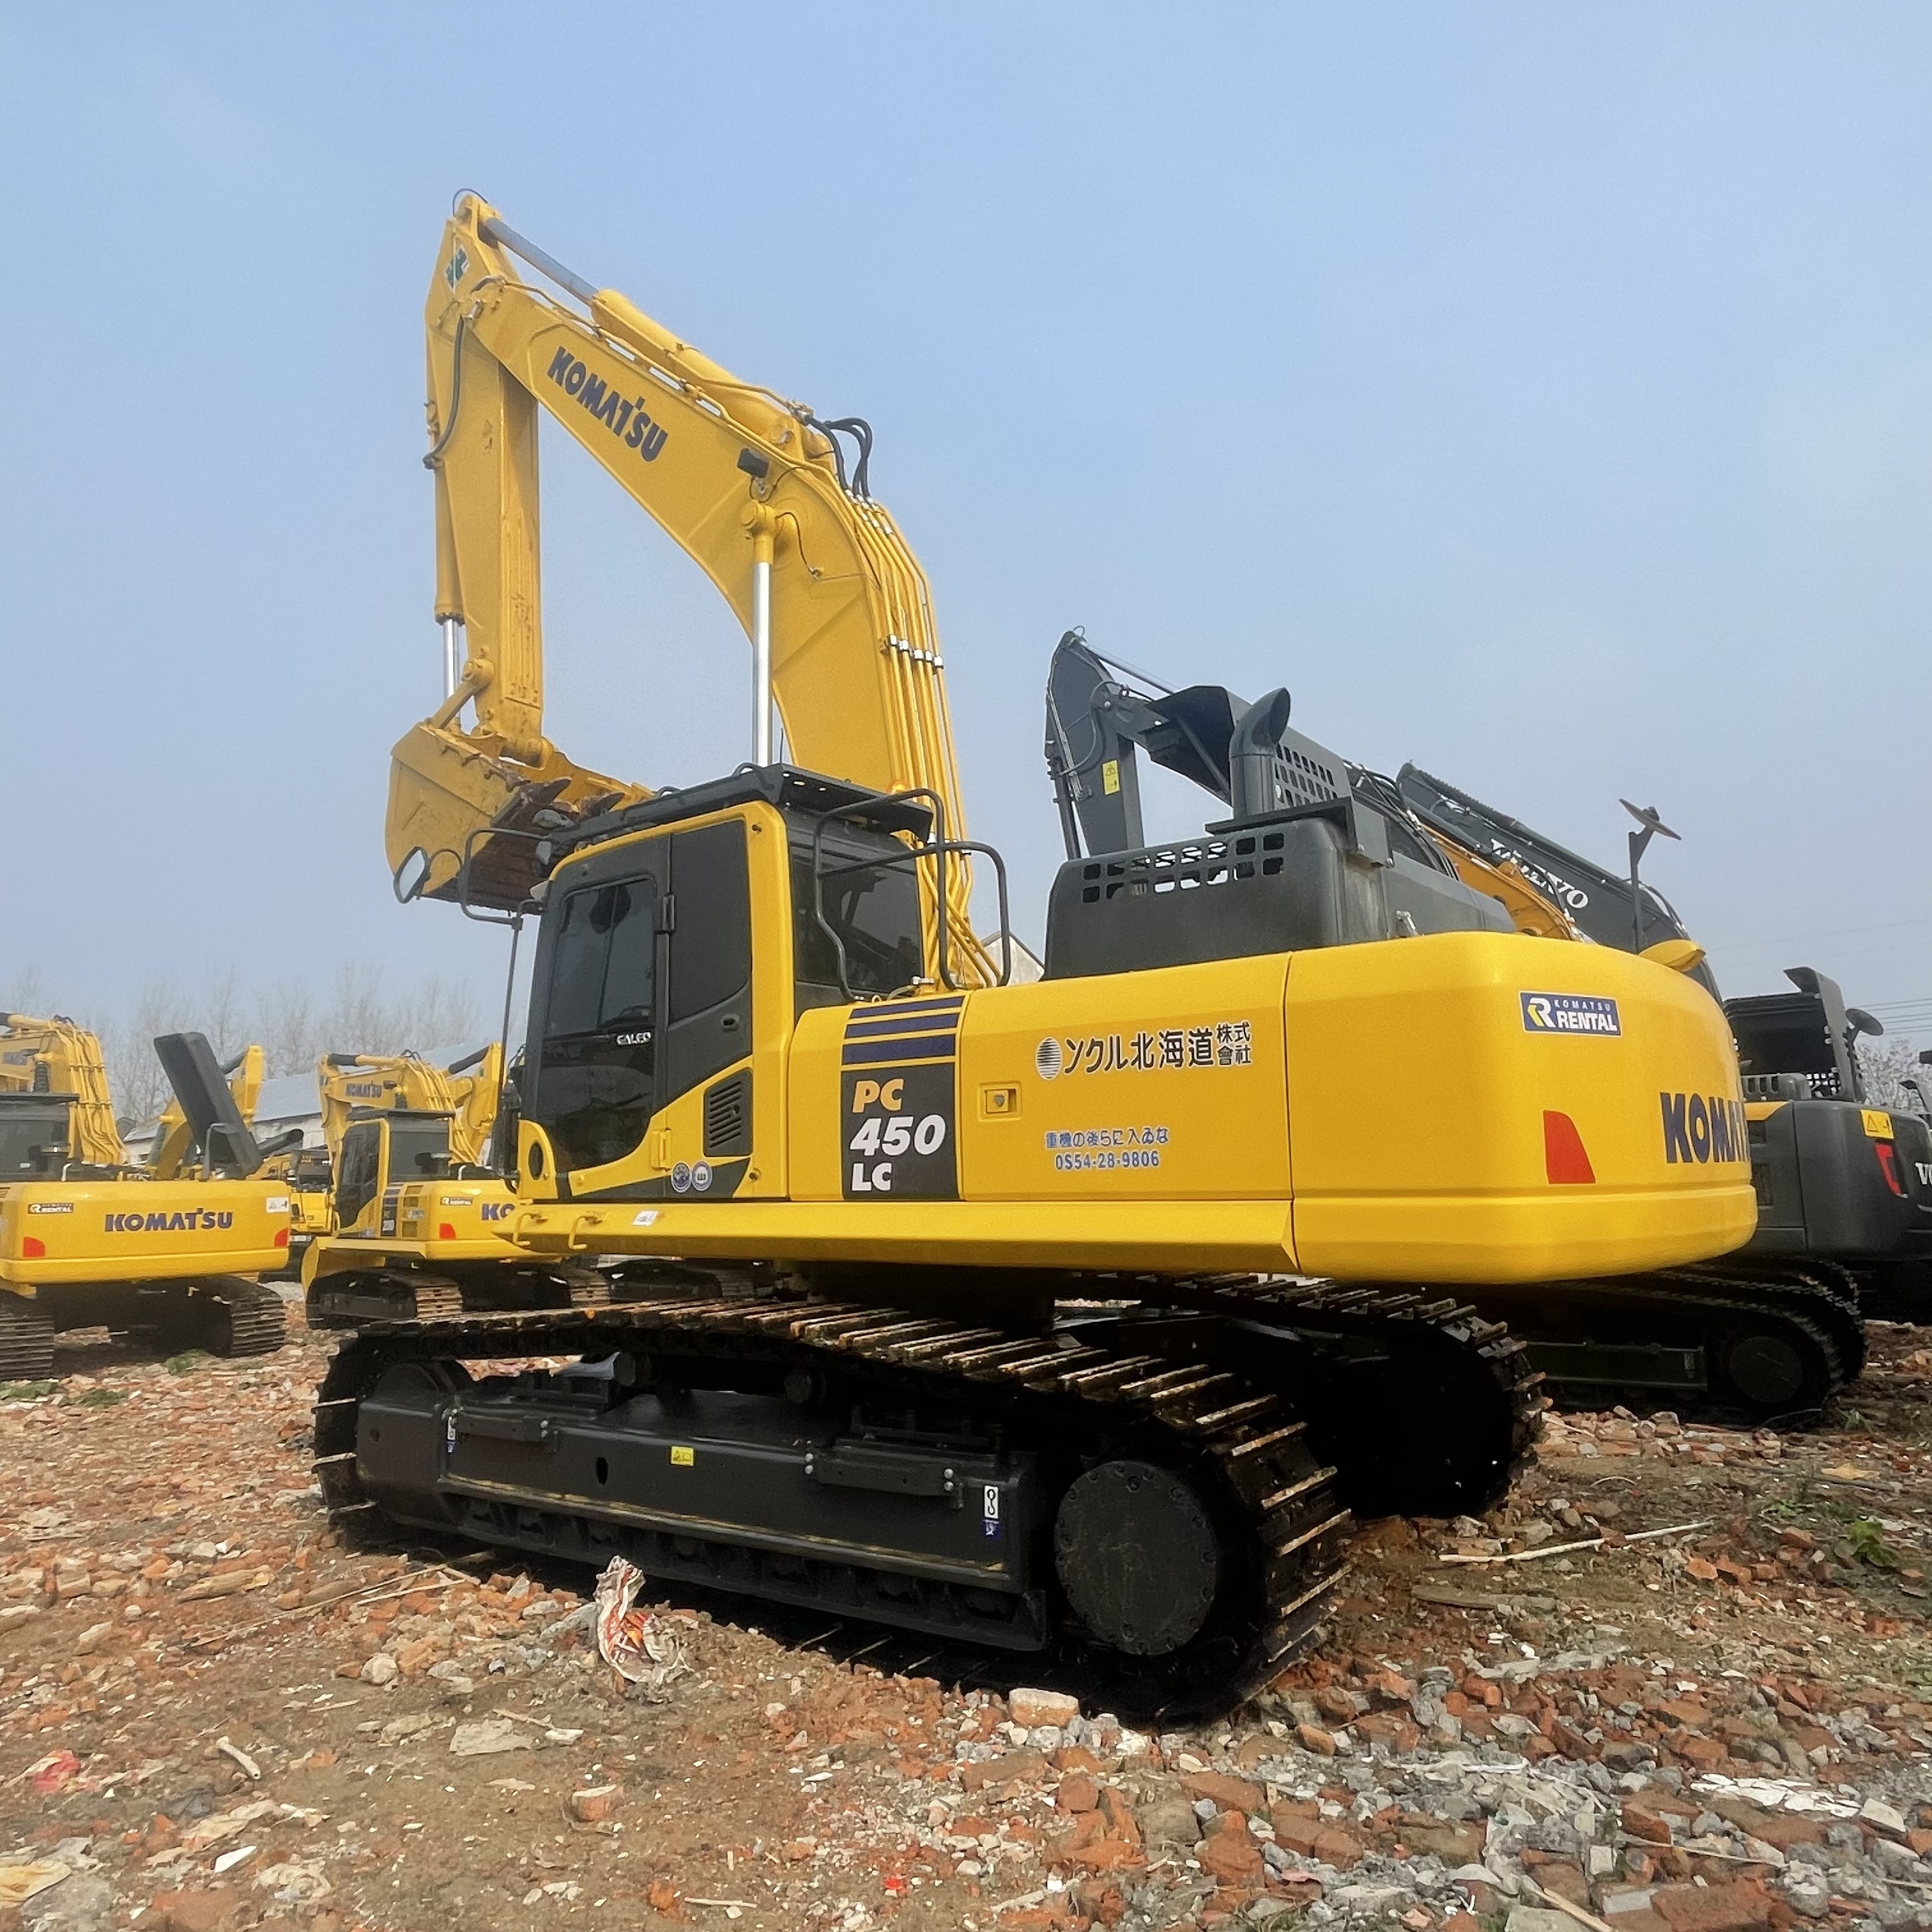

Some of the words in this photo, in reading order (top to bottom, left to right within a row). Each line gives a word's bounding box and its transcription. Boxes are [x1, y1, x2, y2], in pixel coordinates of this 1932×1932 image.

[548, 346, 668, 462] KOMATSU
[1554, 999, 1611, 1011] KOMATSU
[1556, 1011, 1618, 1031] RENTAL
[852, 1078, 905, 1112] PC
[850, 1114, 946, 1156] 450
[852, 1163, 893, 1191] LC
[105, 1208, 233, 1232] KOMATSU
